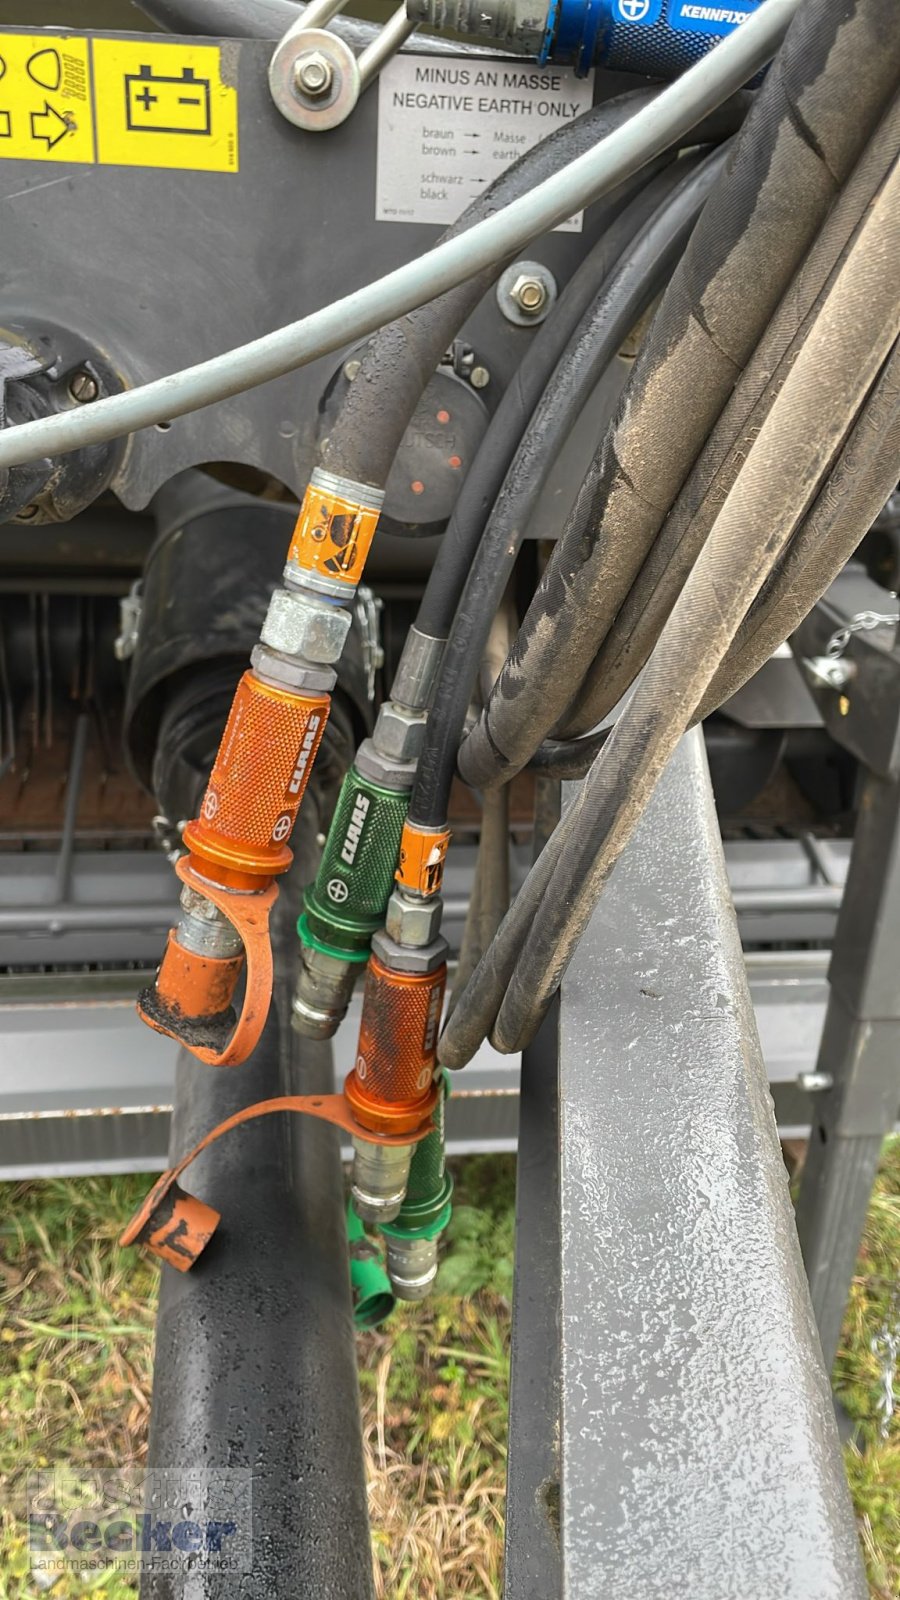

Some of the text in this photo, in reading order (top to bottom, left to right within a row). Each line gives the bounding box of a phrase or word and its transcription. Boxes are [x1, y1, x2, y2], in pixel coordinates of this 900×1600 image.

[415, 67, 561, 91] MINUS AN MASSE
[393, 92, 580, 118] NEGATIVE EARTH ONLY
[422, 126, 454, 139] braun
[494, 131, 527, 145] Masse
[421, 143, 456, 156] brown
[420, 173, 464, 185] schwarz
[420, 187, 448, 201] black
[289, 715, 321, 794] CLAAS
[341, 793, 371, 865] CLAAS
